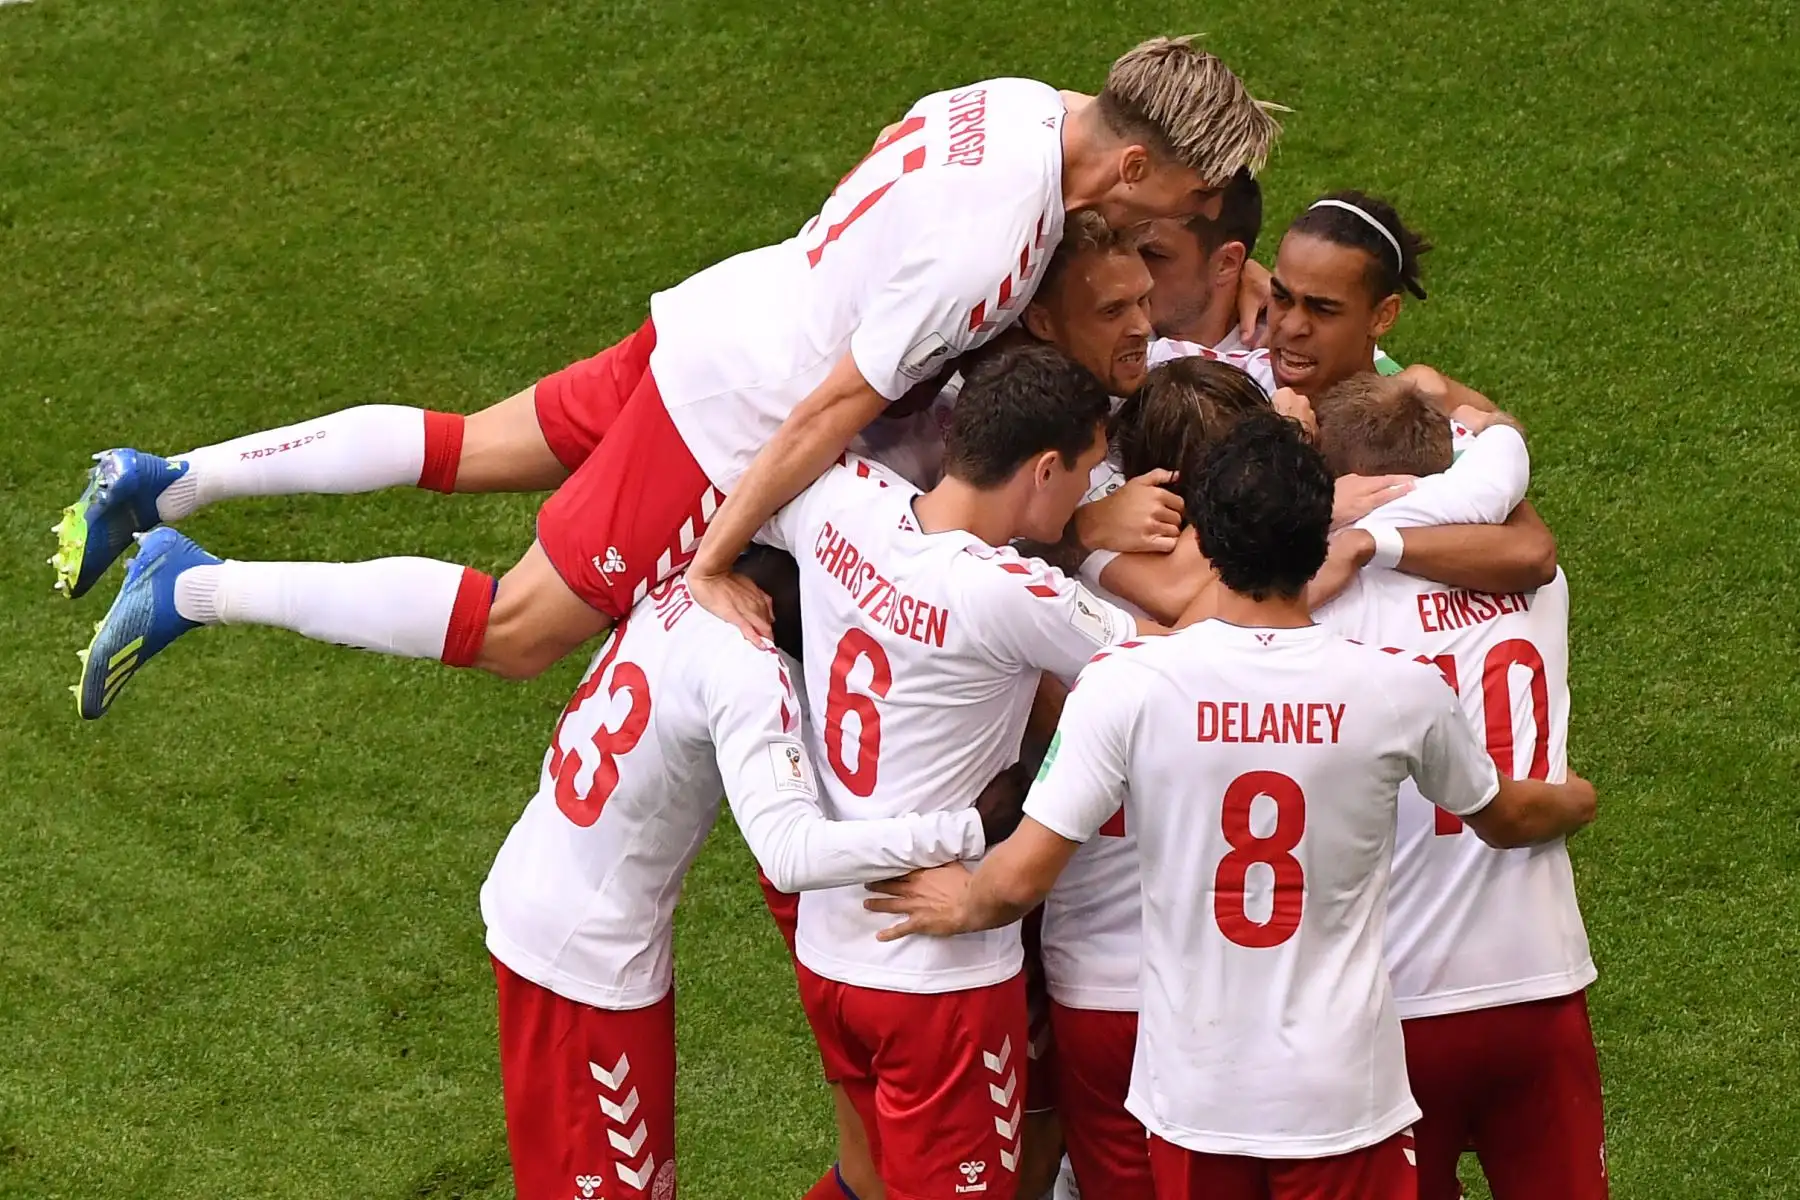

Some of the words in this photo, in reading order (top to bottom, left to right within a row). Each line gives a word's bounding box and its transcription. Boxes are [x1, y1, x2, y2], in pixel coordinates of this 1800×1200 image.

[815, 521, 949, 648] CHRISTENSEN
[823, 626, 893, 798] 6
[1197, 701, 1346, 745] DELANEY
[1432, 638, 1550, 836] 0
[1213, 769, 1307, 949] 8
